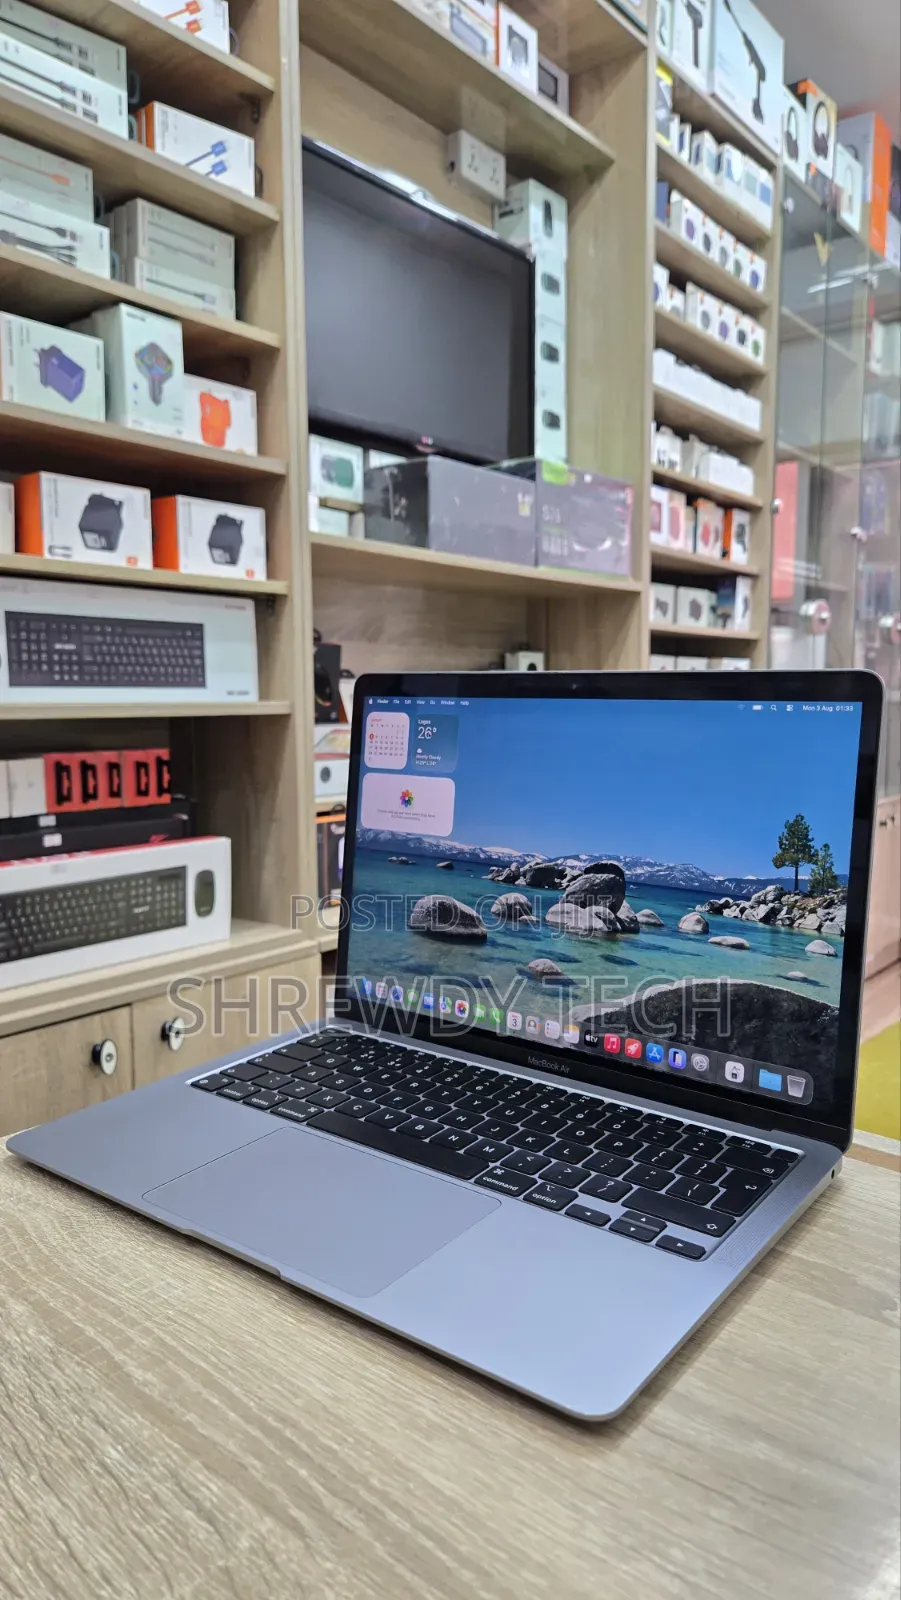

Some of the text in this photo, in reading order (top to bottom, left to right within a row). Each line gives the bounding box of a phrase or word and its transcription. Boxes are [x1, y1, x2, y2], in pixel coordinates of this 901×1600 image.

[511, 1018, 518, 1028] 3
[590, 1035, 599, 1043] tv
[527, 1055, 570, 1074] MacBook Air
[278, 1107, 306, 1118] command
[482, 1176, 519, 1191] command
[532, 1192, 557, 1204] option
